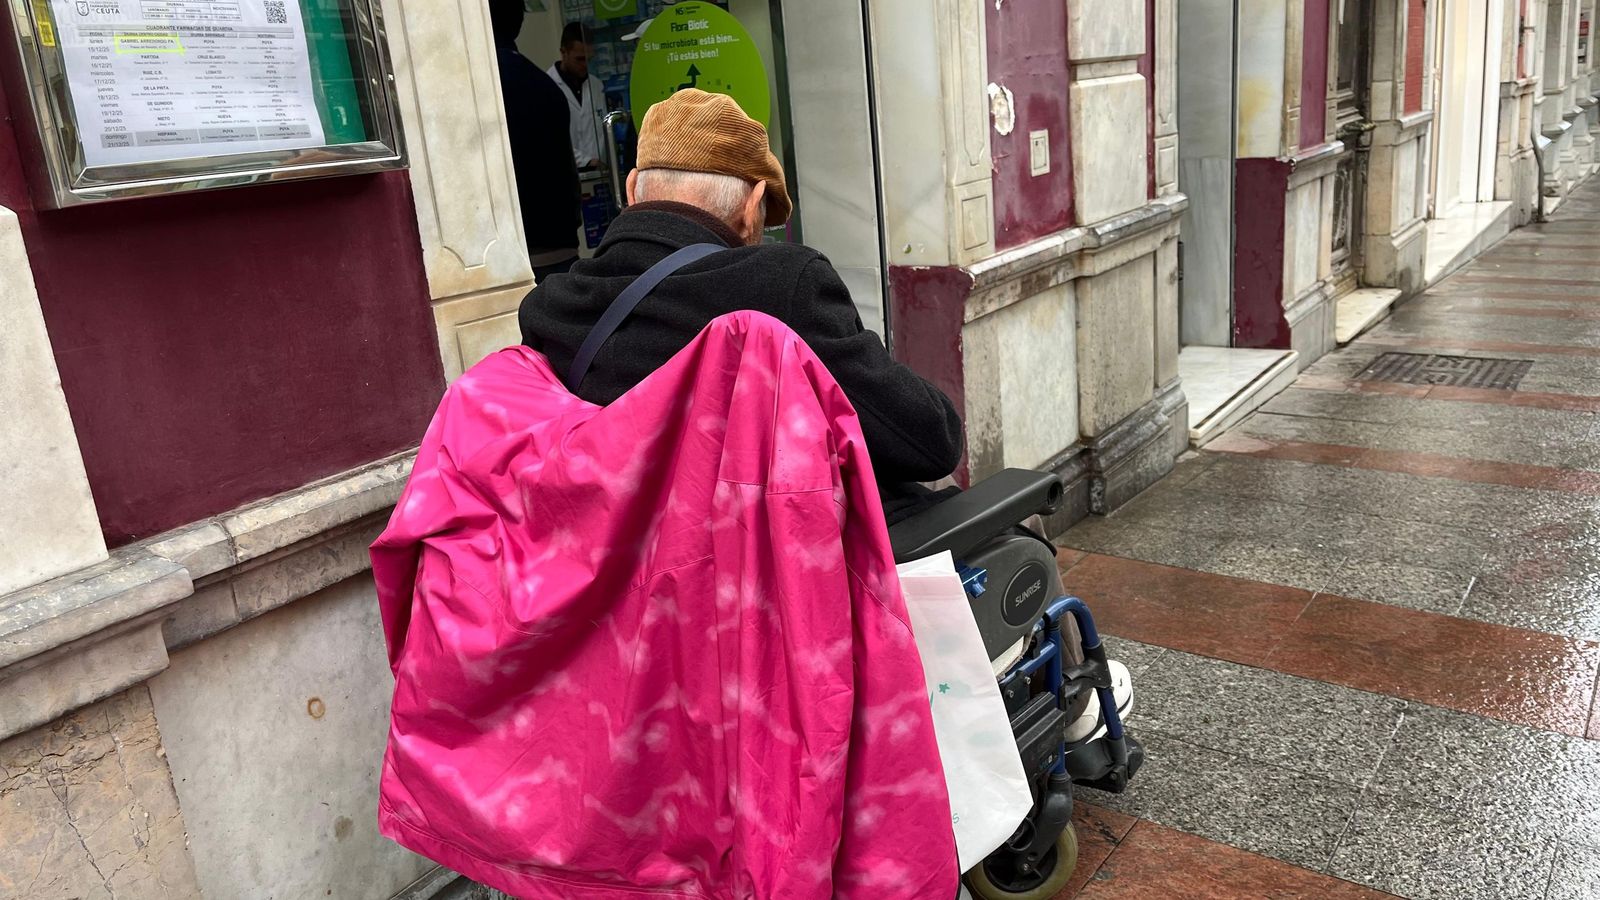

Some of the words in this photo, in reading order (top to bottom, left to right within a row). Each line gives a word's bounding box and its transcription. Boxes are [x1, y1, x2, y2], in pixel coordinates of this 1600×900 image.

[644, 43, 651, 51] Si
[652, 42, 660, 50] tu
[660, 38, 698, 49] microbiota
[700, 35, 715, 45] está
[680, 51, 699, 60] estás
[700, 48, 719, 58] bien!
[1015, 579, 1041, 607] SUNRISE
